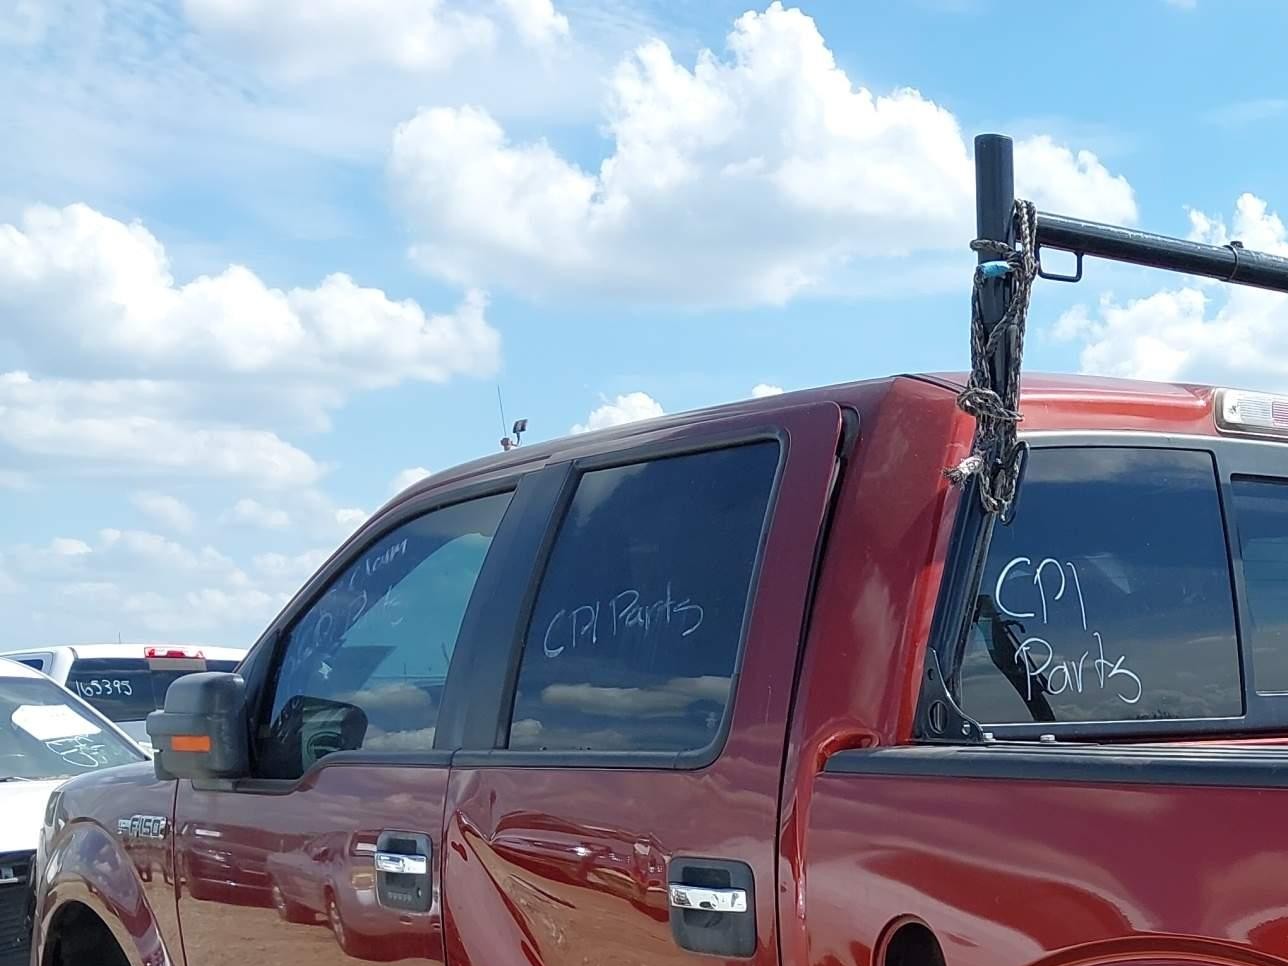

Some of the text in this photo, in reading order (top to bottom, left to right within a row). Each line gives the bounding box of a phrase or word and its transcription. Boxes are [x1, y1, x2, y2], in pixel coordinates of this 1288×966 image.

[608, 580, 705, 637] Parts
[75, 679, 133, 698] 165395
[1014, 631, 1142, 704] Parts
